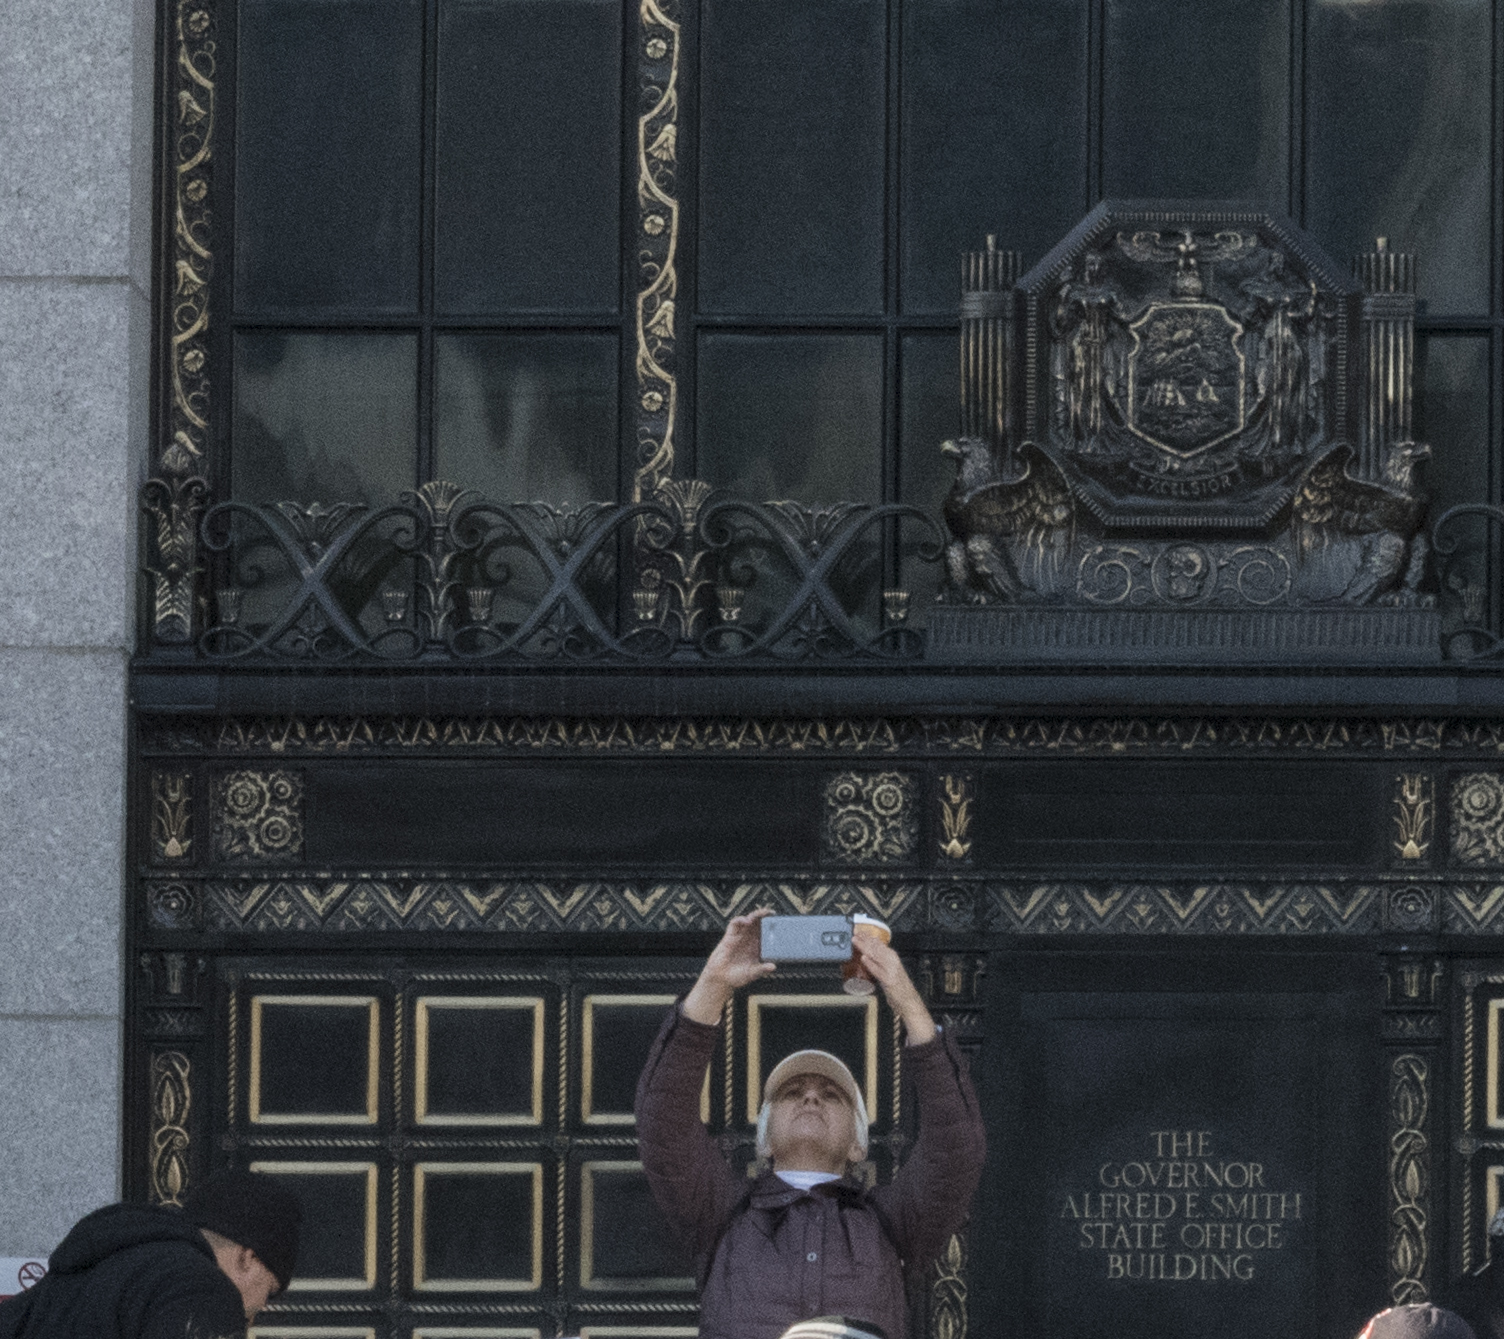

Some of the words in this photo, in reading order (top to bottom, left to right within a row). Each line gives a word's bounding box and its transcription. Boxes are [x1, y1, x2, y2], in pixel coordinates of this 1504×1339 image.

[1150, 1131, 1214, 1158] THE
[1099, 1162, 1265, 1188] GOVERNOR
[1060, 1193, 1177, 1219] ALFRED
[1211, 1193, 1302, 1219] SMITH
[1080, 1223, 1167, 1249] STATE
[1180, 1223, 1283, 1249] OFFICE
[1107, 1254, 1256, 1281] BUILDING
